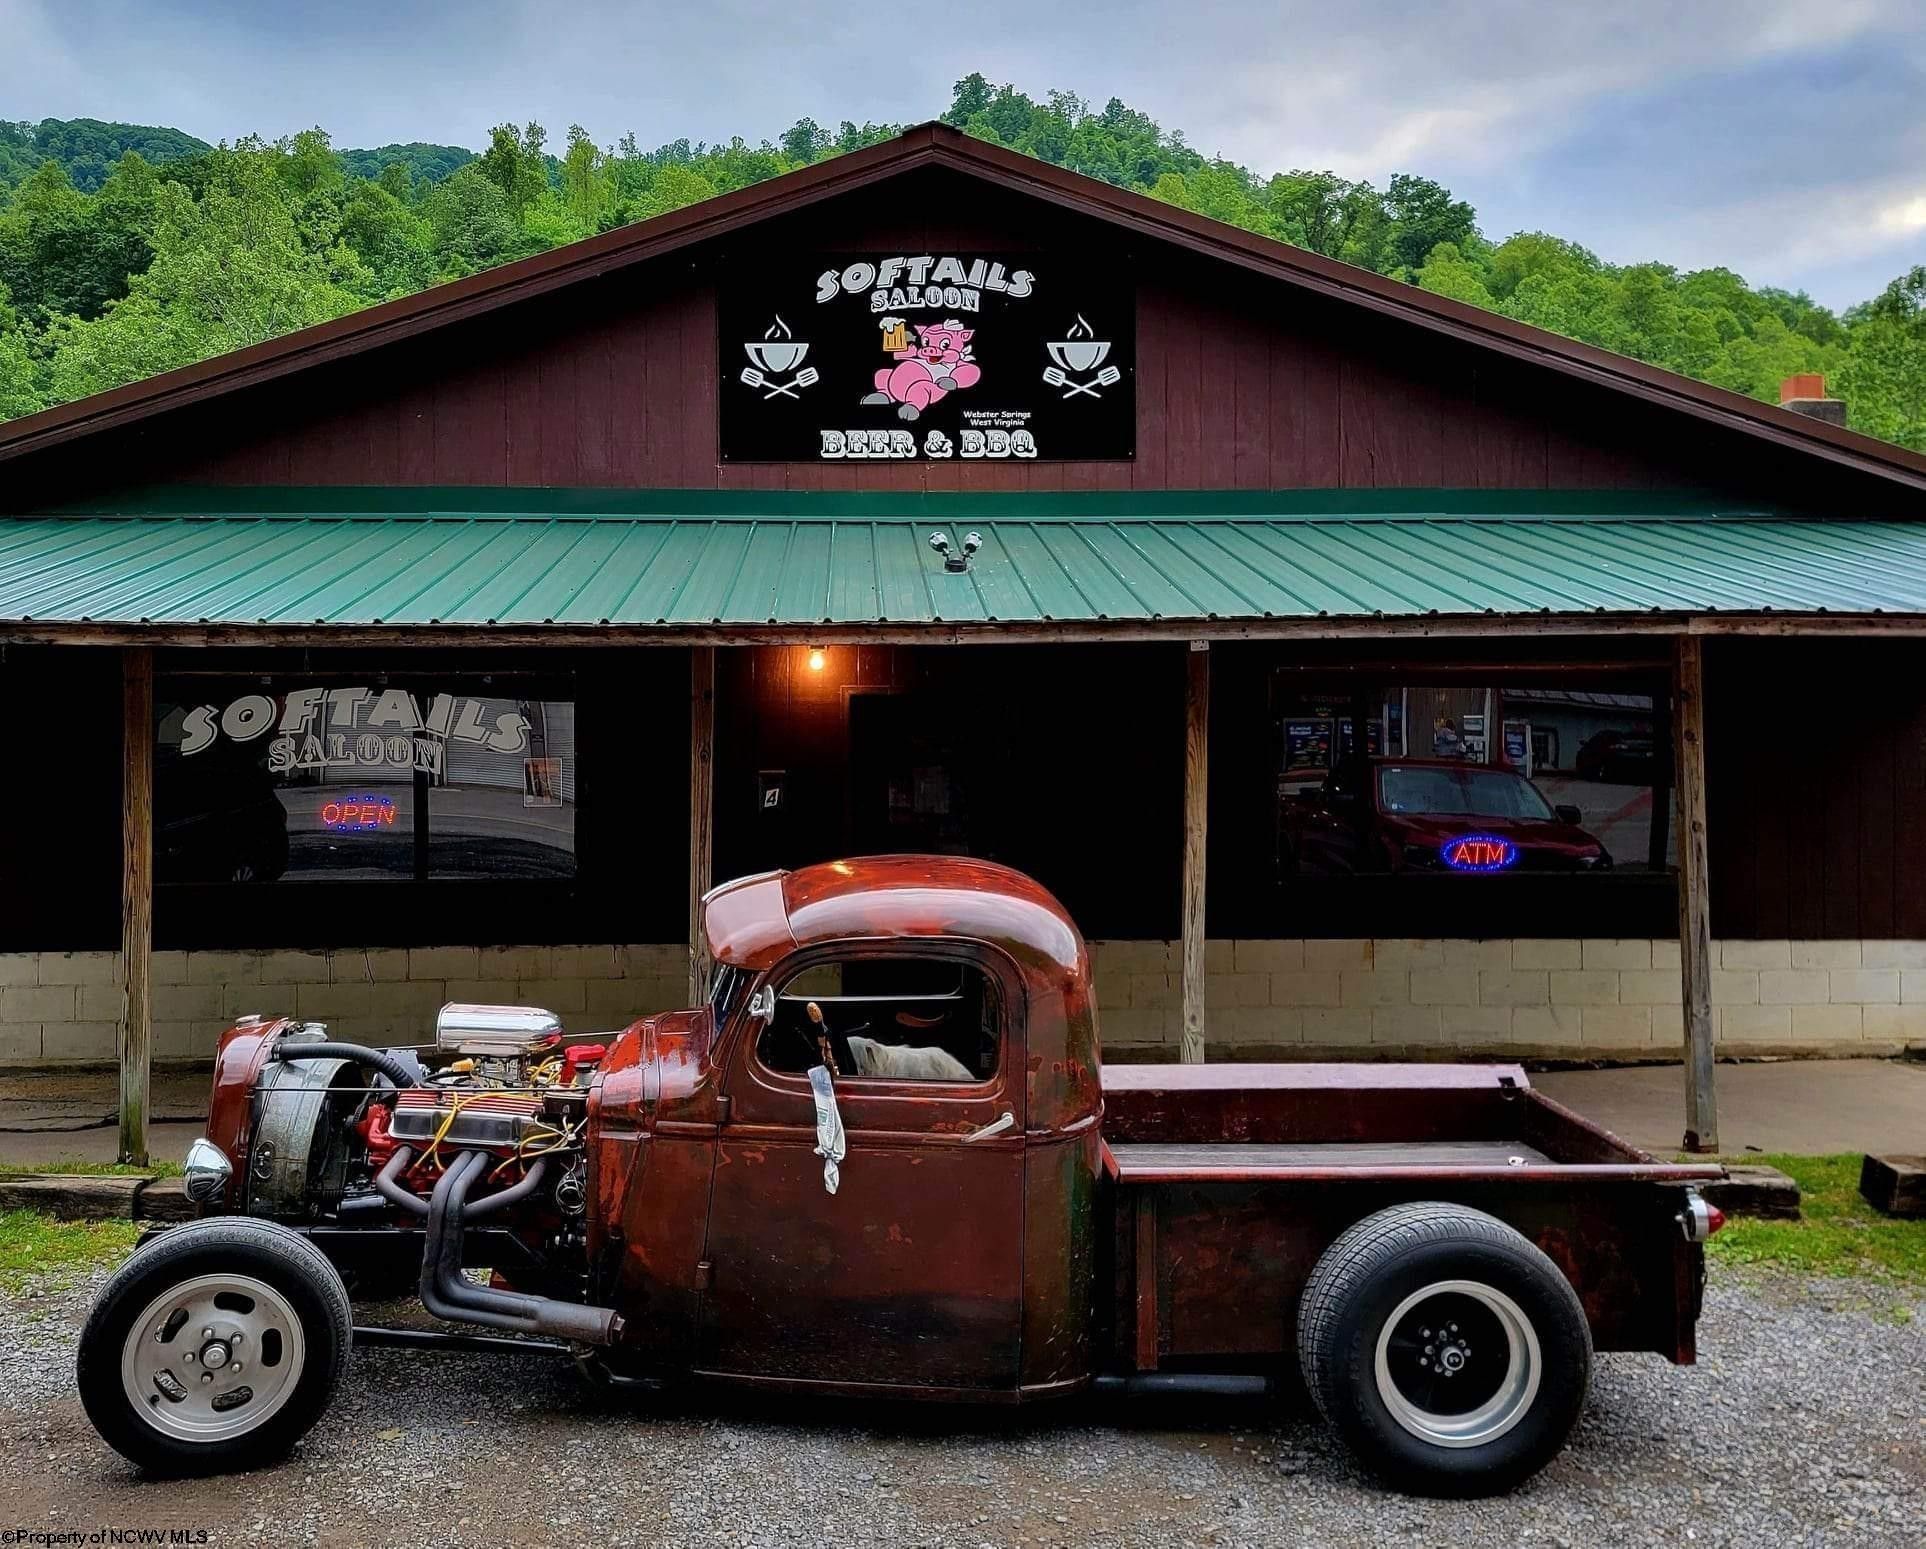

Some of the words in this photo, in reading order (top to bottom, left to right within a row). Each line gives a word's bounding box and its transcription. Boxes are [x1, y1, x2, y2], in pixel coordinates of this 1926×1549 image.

[816, 256, 1037, 303] SOFTAILS
[870, 286, 981, 313] SALOON
[963, 410, 999, 418] Webster
[1001, 410, 1031, 419] Springs
[994, 419, 1024, 427] Virginia
[820, 429, 917, 458] BEER
[924, 429, 953, 458] &
[960, 429, 1037, 458] BBQ
[180, 687, 533, 756] SOFTAILS
[268, 732, 443, 775] SALOON
[323, 804, 396, 824] OPEN
[1454, 842, 1504, 864] ATM
